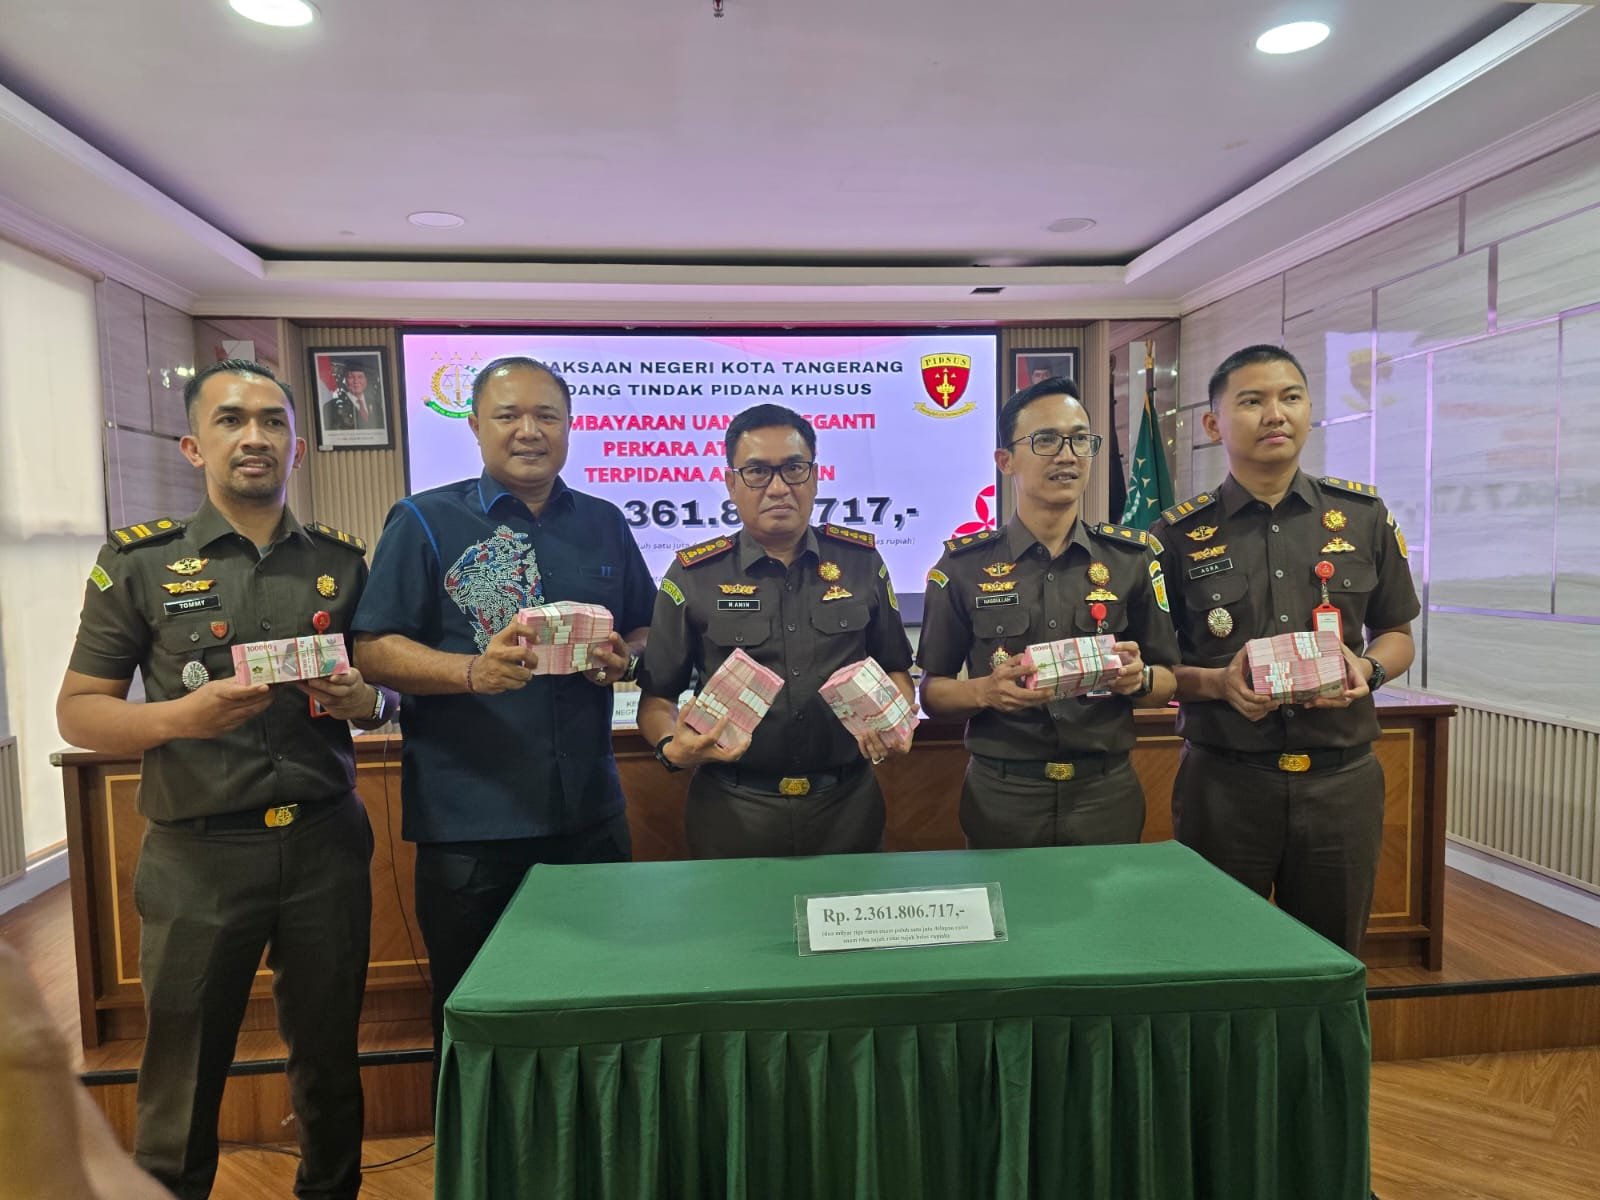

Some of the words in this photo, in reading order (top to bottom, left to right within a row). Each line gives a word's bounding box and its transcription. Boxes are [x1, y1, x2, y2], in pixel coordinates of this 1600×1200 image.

[543, 361, 632, 374] AKSAAN
[640, 361, 714, 374] NEGERI
[722, 361, 776, 374] KOTA
[782, 361, 903, 374] TANGERANG
[925, 356, 968, 367] PIDSUS
[567, 384, 621, 396] DANG
[628, 384, 703, 396] TINDAK
[711, 384, 784, 396] PIDANA
[791, 383, 872, 395] KHUSUS
[571, 415, 686, 431] MBAYARAN
[692, 415, 735, 431] UAN
[603, 441, 699, 457] PERKARA
[702, 440, 727, 457] AT
[584, 466, 705, 483] TERPIDANA
[179, 600, 205, 609] TOMMY
[823, 909, 850, 926] Rp.
[855, 903, 965, 921] 2.361.806.717,-
